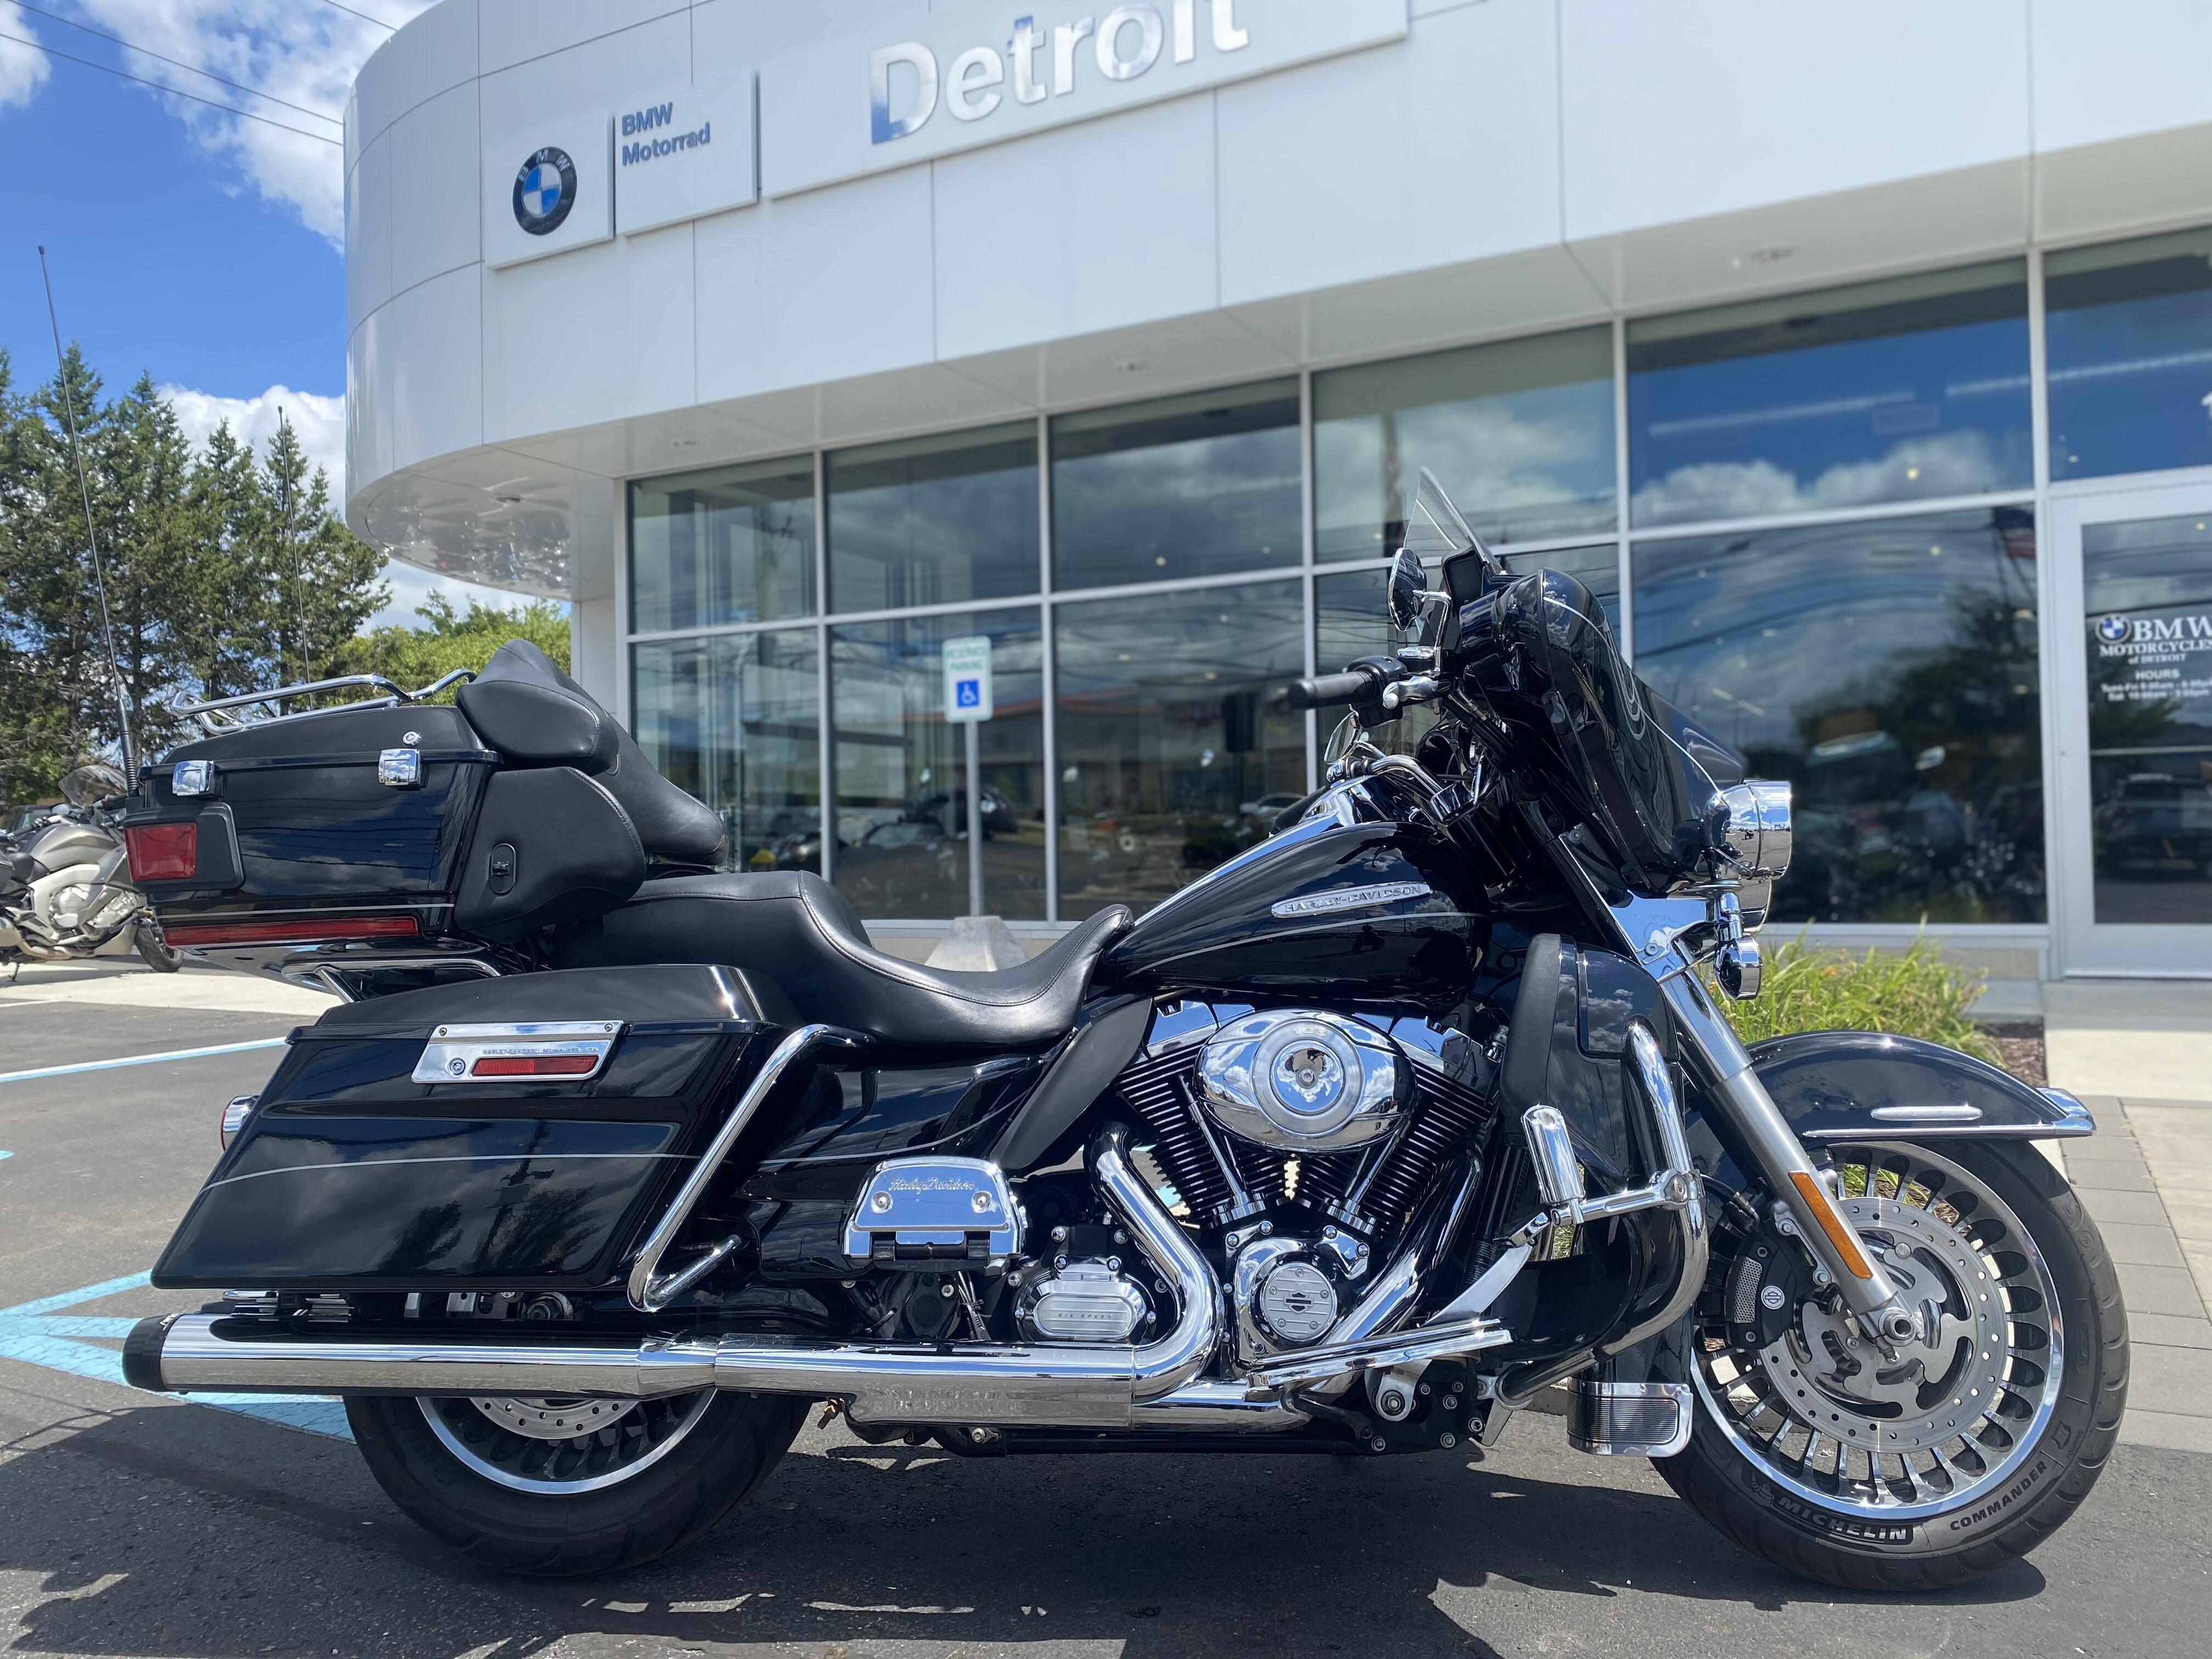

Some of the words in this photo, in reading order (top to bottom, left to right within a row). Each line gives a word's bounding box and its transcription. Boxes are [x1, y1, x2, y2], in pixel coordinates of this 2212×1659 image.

[871, 0, 1249, 145] Detroit
[621, 102, 673, 137] BMW
[622, 122, 710, 166] Motorrad
[517, 149, 571, 181] BMW
[2132, 616, 2212, 642] BMW
[2141, 653, 2187, 663] DETROIT
[2135, 669, 2180, 681] HOURS
[1284, 885, 1421, 912] HARLEY-DAVIDSON
[1950, 1460, 2048, 1531] COMMANDER
[1778, 1494, 1909, 1541] MICHELIN
